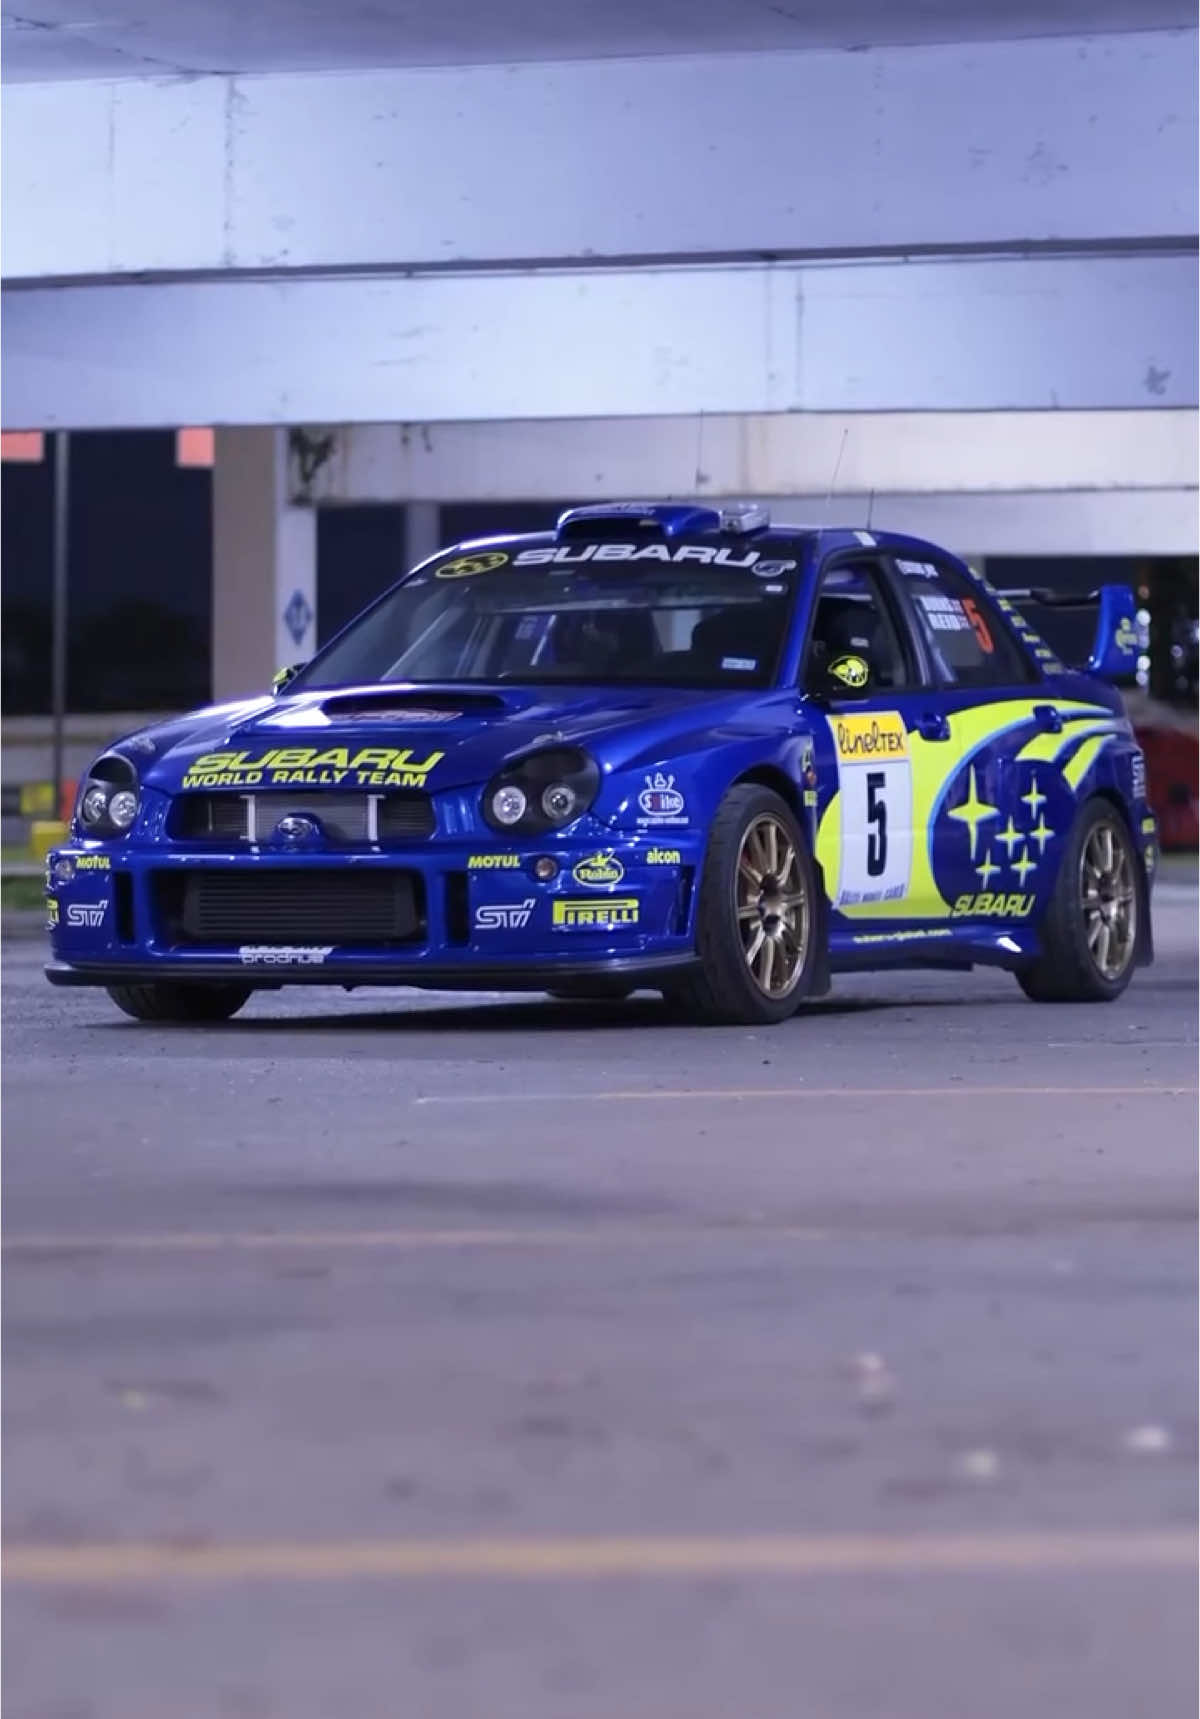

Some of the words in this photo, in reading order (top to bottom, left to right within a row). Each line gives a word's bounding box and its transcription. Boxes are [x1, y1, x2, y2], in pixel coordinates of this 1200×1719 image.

[512, 543, 761, 568] SUBARU
[961, 596, 995, 655] 5
[189, 748, 446, 775] SUBARU
[182, 771, 263, 789] WORLD
[272, 770, 349, 785] RALLY
[357, 770, 428, 787] TEAM
[865, 772, 888, 877] 5
[76, 855, 112, 870] MOTUL
[468, 855, 521, 869] MOTUL
[646, 847, 681, 864] alcon
[552, 898, 639, 926] PIRELLI
[950, 893, 1036, 918] SUBARU
